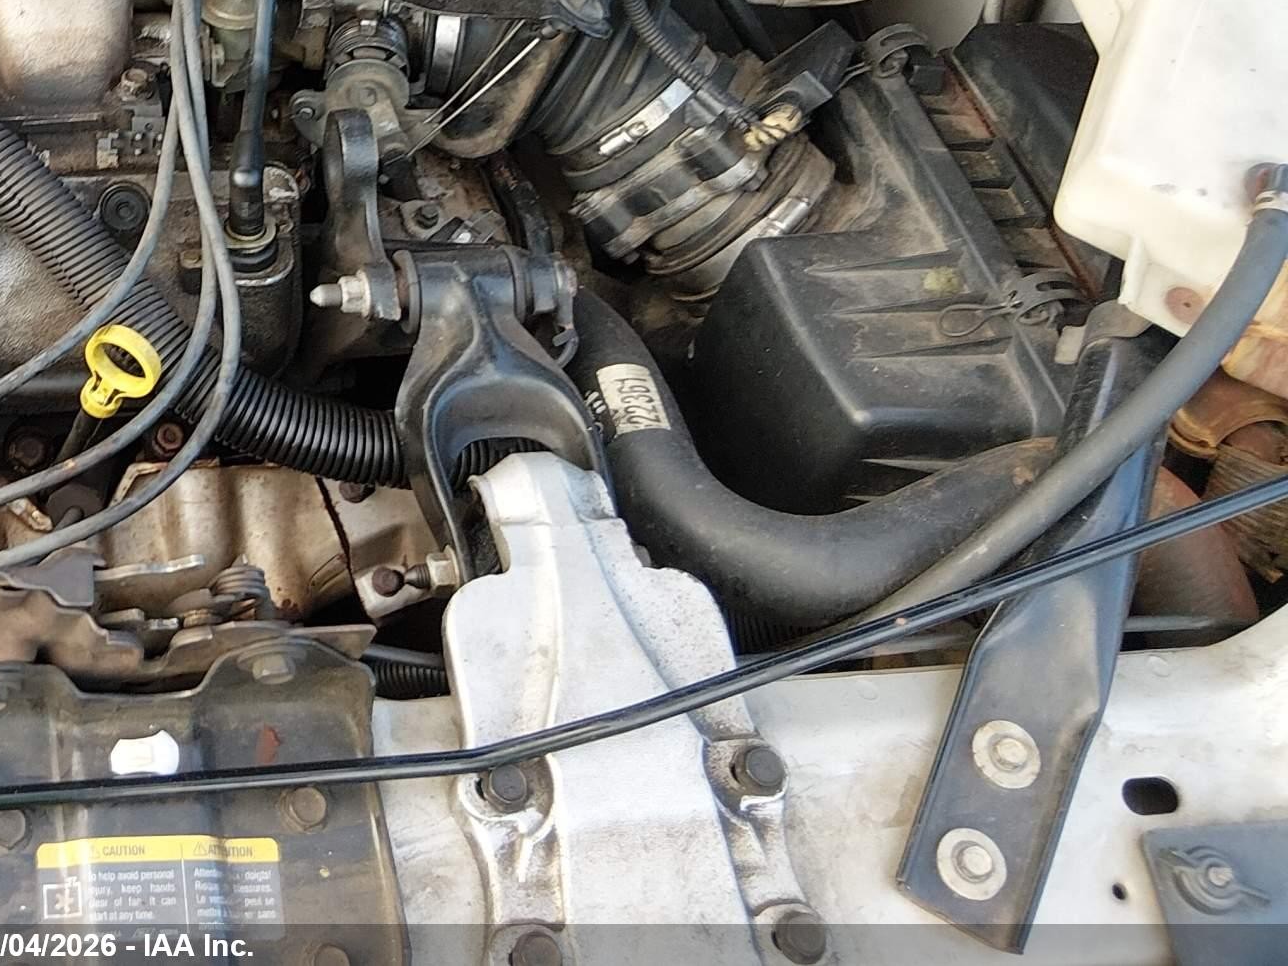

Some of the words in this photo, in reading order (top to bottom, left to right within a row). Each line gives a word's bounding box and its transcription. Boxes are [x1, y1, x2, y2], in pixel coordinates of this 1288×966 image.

[102, 845, 145, 857] CAUTION
[121, 883, 142, 894] keep
[160, 896, 177, 906] can
